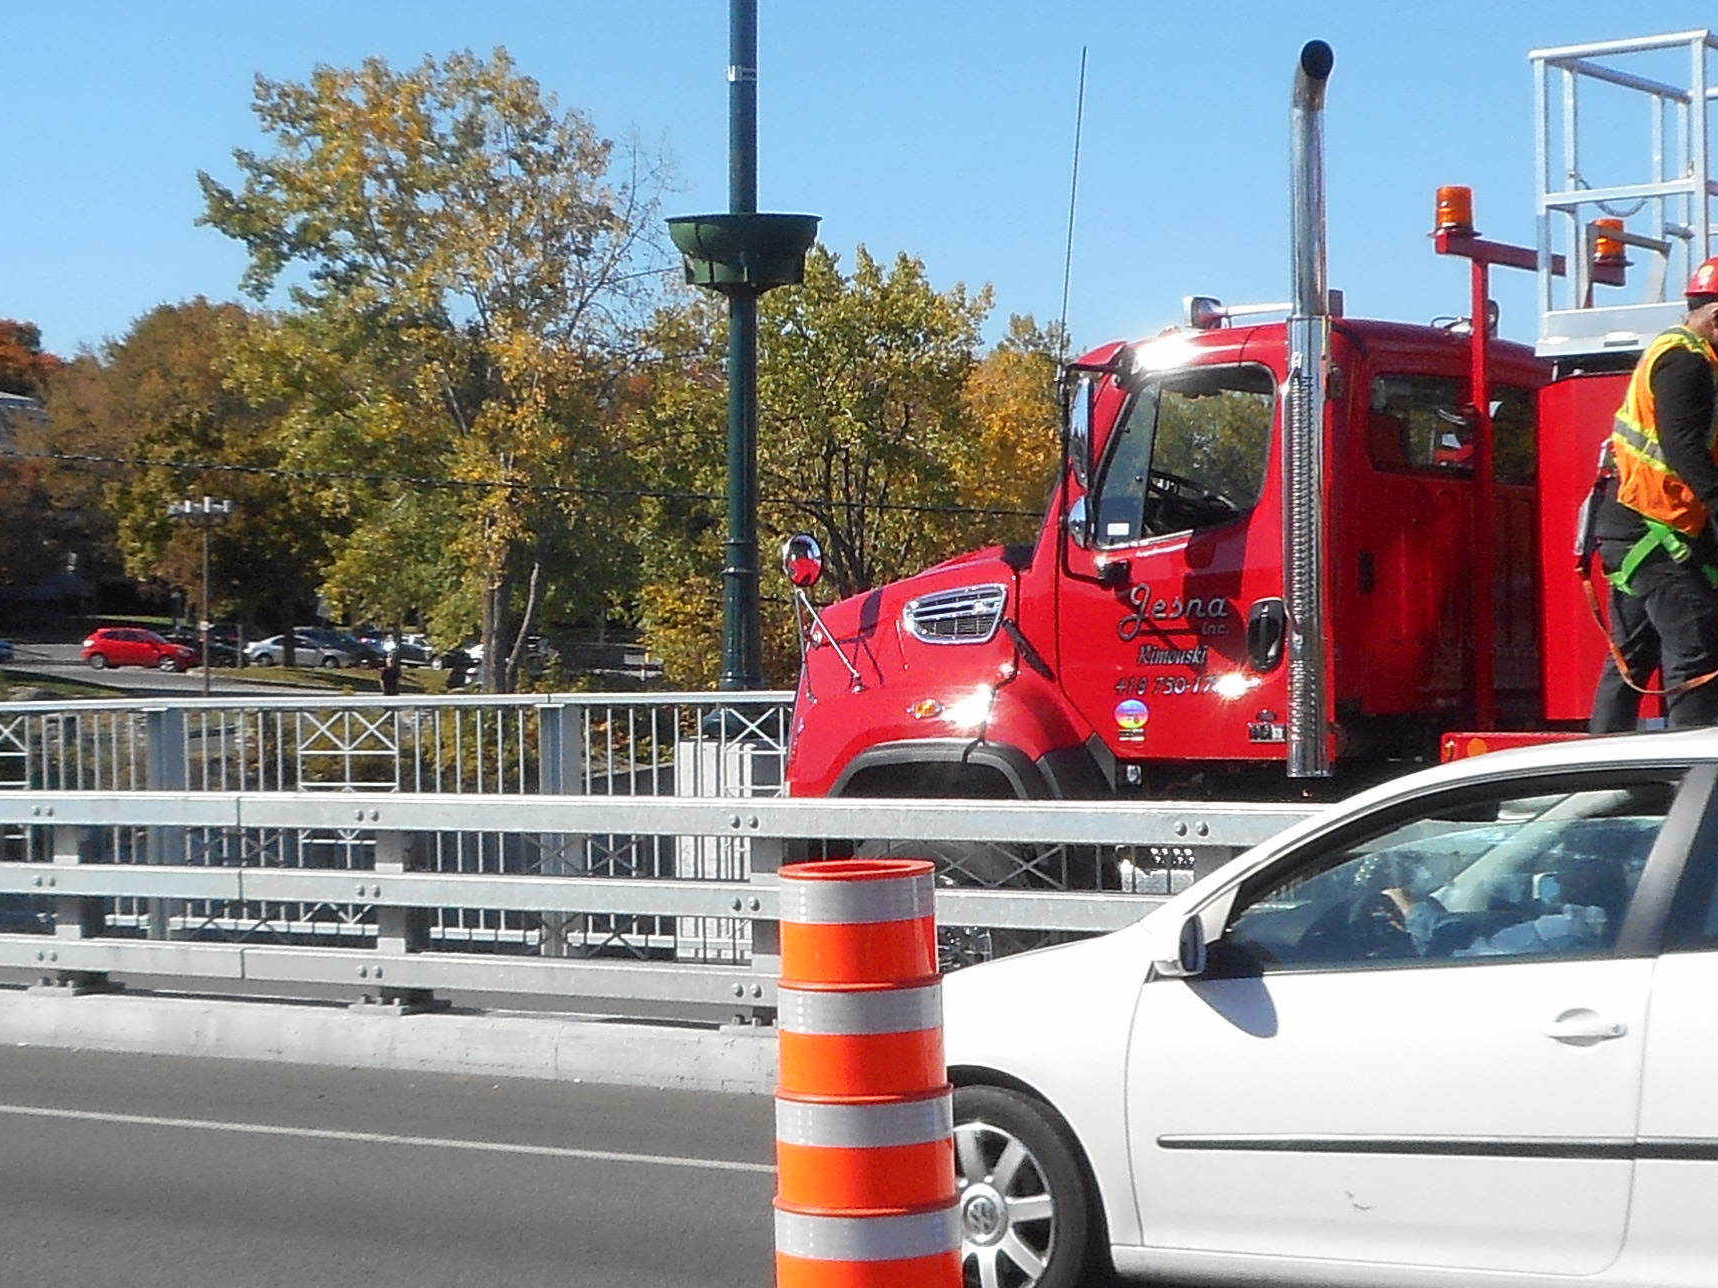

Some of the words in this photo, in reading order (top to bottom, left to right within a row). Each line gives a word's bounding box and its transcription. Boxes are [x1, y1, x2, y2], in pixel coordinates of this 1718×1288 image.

[1117, 583, 1229, 641] Jesna
[1137, 645, 1209, 666] Rimouski
[1114, 675, 1149, 696] 418
[1153, 673, 1219, 696] 750-17
